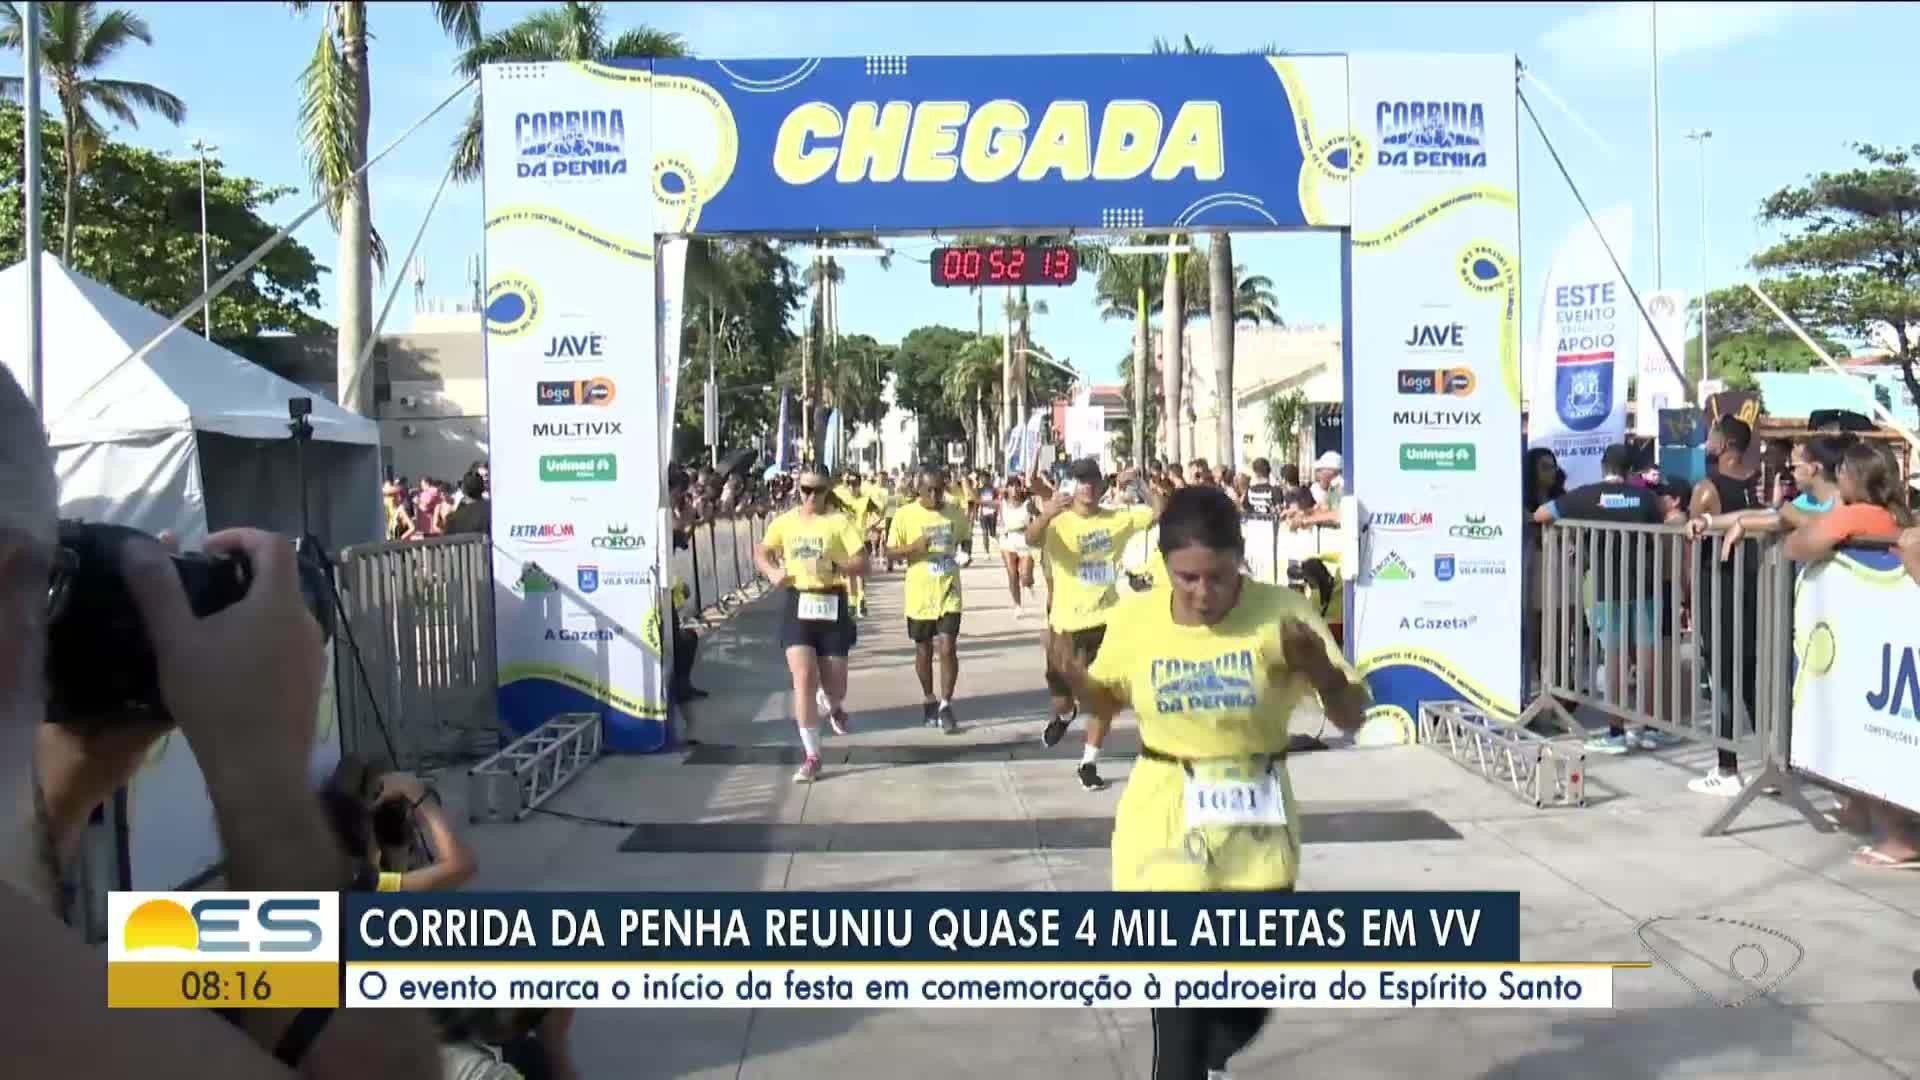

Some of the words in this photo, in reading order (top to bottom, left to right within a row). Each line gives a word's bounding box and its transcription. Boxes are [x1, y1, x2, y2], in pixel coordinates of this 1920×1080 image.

[1376, 101, 1485, 136] CORRIDA
[514, 109, 626, 147] CORRIDA
[773, 100, 1224, 185] CHEGADA
[516, 159, 547, 178] DA
[553, 158, 628, 177] PENHA
[1377, 151, 1409, 167] DA
[1413, 150, 1488, 168] PENHA
[1556, 281, 1616, 307] ESTE
[1556, 306, 1616, 324] EVENTO
[1557, 334, 1615, 352] APOIO
[1393, 411, 1482, 425] MULTIVIX
[532, 422, 623, 437] MULTIVIX
[1406, 448, 1454, 460] Unimed
[546, 459, 594, 472] Unimed
[1449, 525, 1503, 537] COROA
[591, 536, 646, 549] COROA
[1400, 617, 1410, 630] A
[1414, 617, 1468, 629] Gazeta
[544, 629, 556, 641] A
[559, 628, 614, 641] Gazeta
[1157, 700, 1183, 714] DA
[1188, 694, 1257, 711] PENHA
